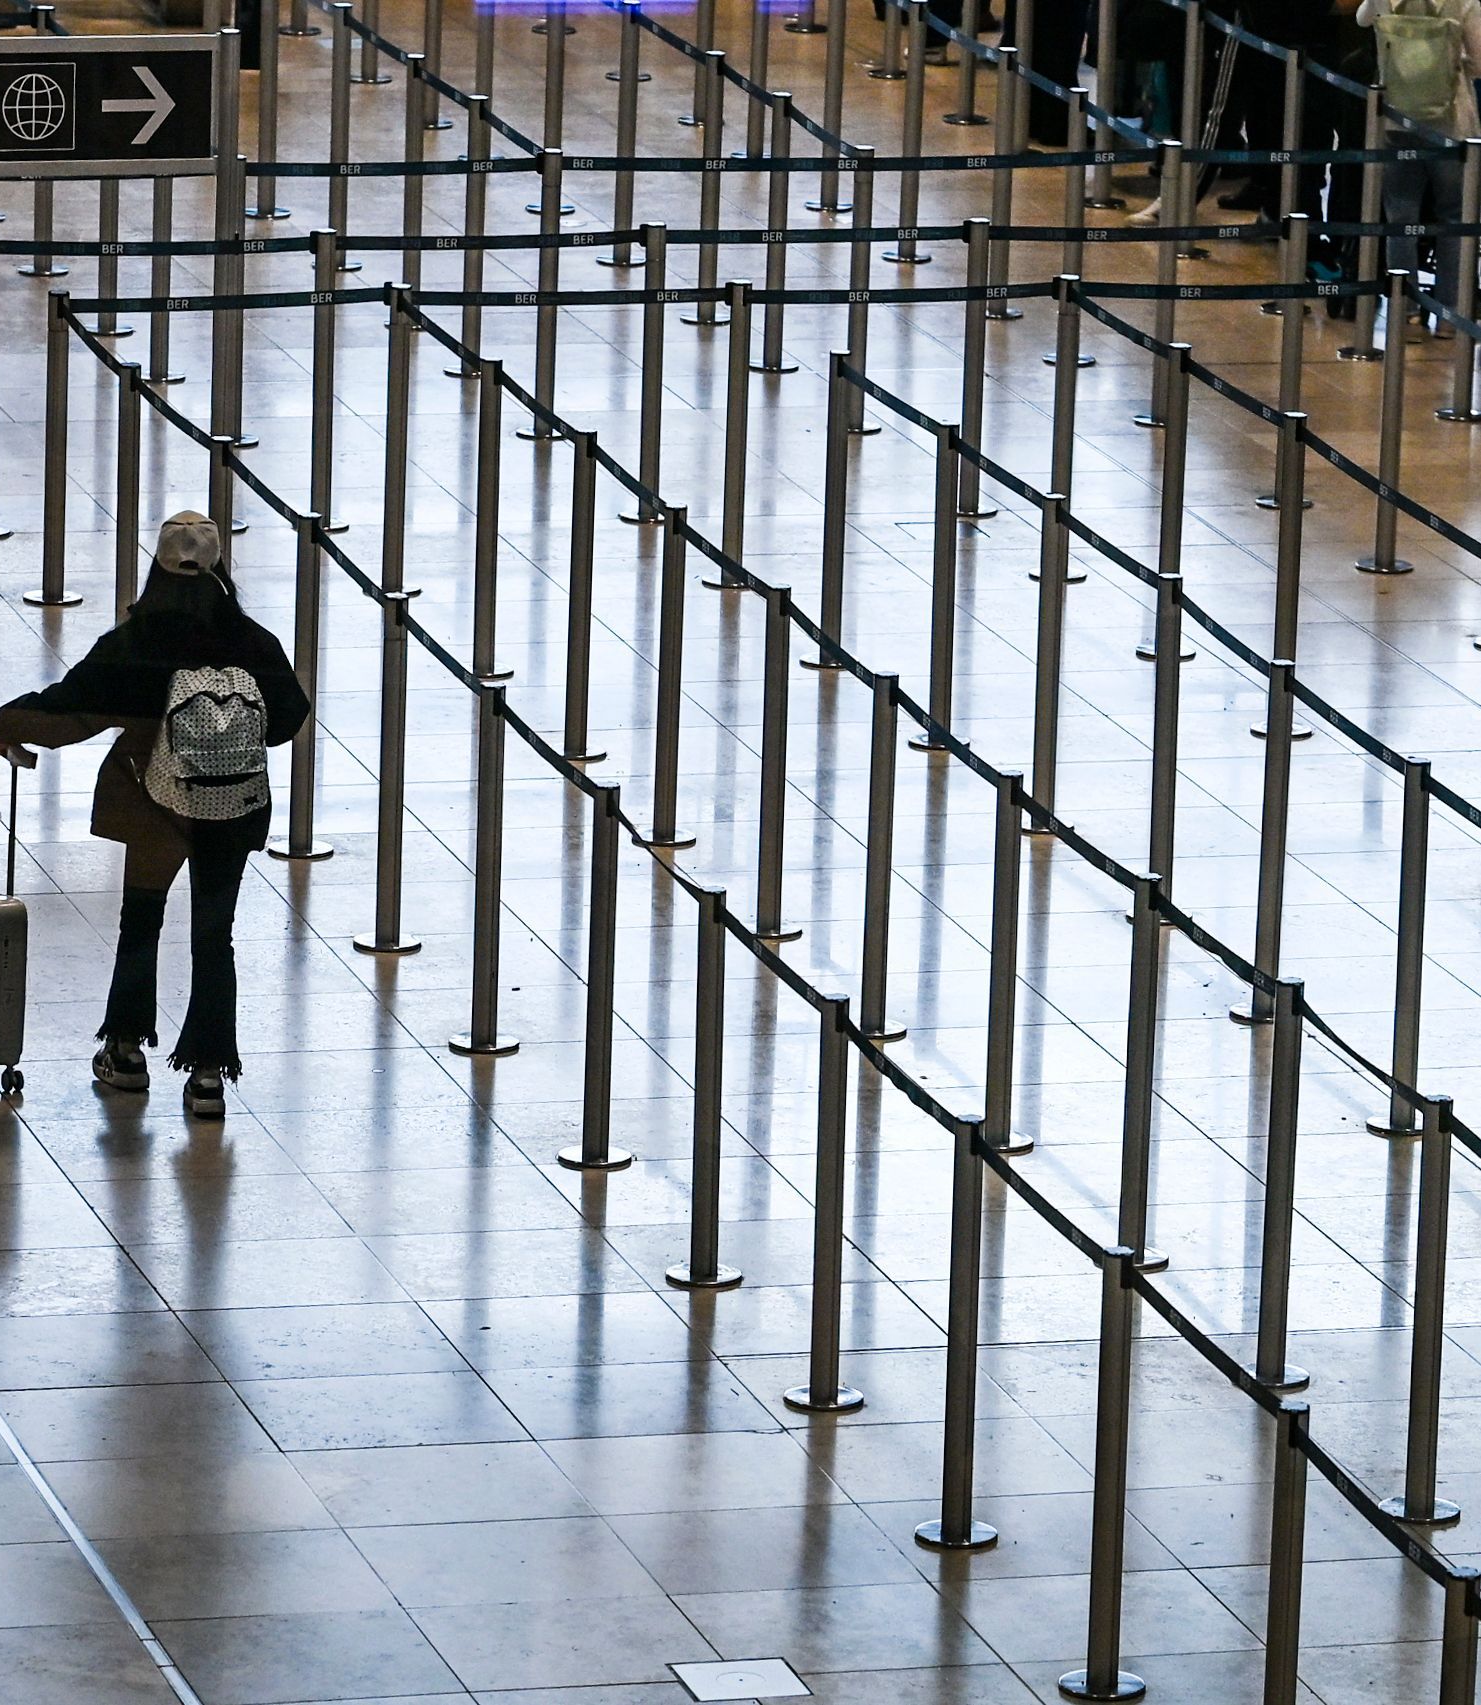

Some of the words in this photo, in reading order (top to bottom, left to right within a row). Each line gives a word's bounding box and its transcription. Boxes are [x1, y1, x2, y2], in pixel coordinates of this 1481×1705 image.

[967, 157, 987, 168] BER
[1094, 152, 1116, 163] BER
[1270, 152, 1291, 163] BER
[1396, 150, 1417, 161] BER
[339, 164, 361, 175] BER
[472, 161, 494, 172] BER
[572, 158, 594, 169] BER
[705, 159, 727, 170] BER
[837, 159, 859, 170] BER
[761, 231, 783, 242] BER
[897, 228, 919, 239] BER
[1086, 230, 1108, 241] BER
[1218, 227, 1240, 238] BER
[1404, 225, 1426, 235] BER
[101, 244, 124, 254] BER
[243, 241, 265, 251] BER
[436, 238, 458, 248] BER
[572, 234, 595, 245] BER
[514, 293, 538, 304] BER
[656, 291, 680, 302] BER
[848, 291, 871, 302] BER
[985, 287, 1008, 299] BER
[1179, 287, 1202, 298] BER
[1316, 284, 1340, 296] BER
[166, 299, 190, 310] BER
[309, 293, 334, 304] BER
